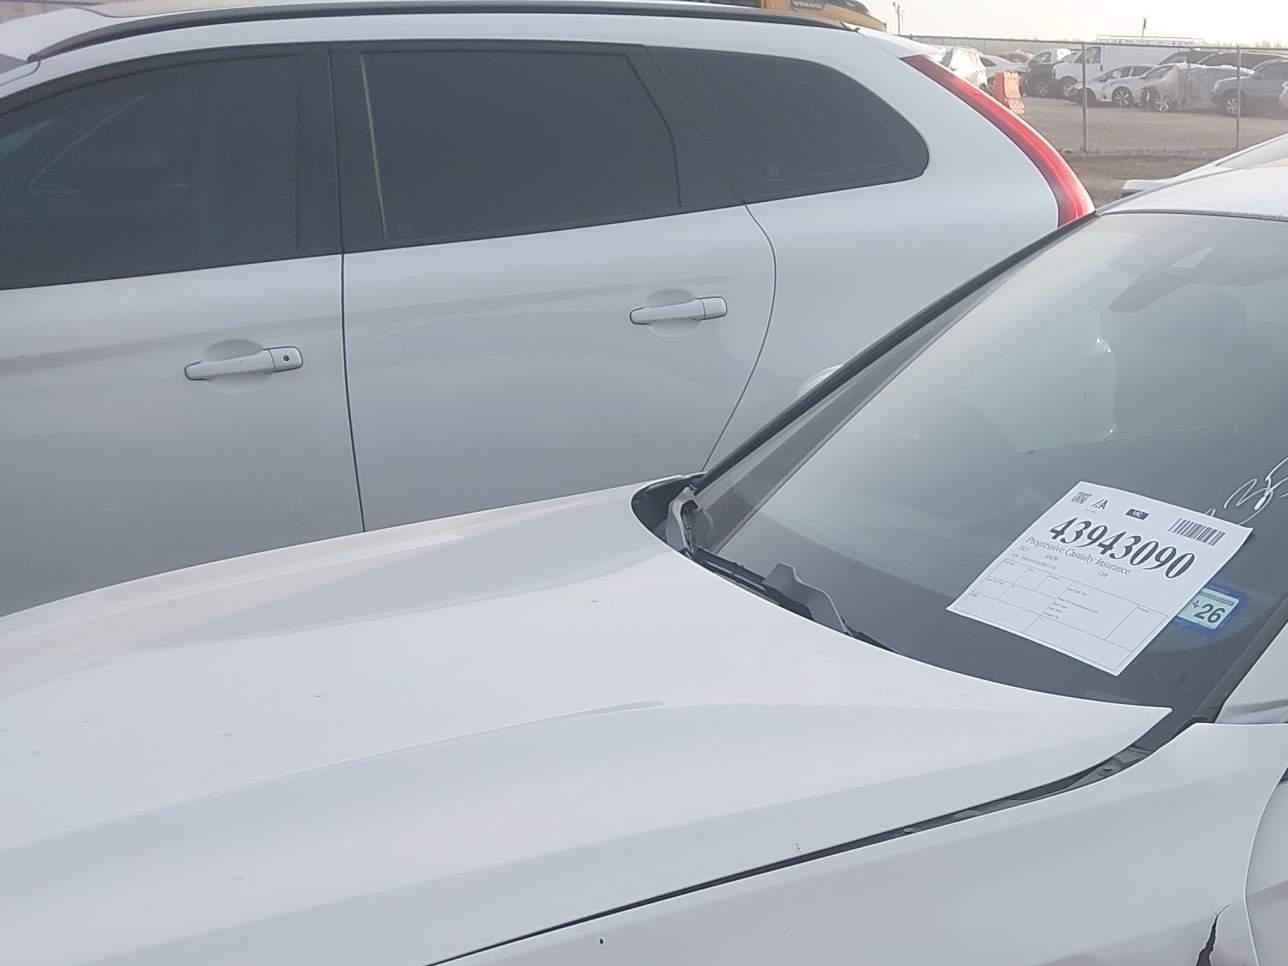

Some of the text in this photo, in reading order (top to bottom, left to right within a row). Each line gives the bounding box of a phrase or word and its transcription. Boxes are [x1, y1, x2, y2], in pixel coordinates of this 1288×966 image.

[1025, 536, 1066, 554] Progressive
[1065, 547, 1097, 565] Casualty
[1095, 558, 1131, 576] Insurance
[1048, 516, 1195, 579] 43943090
[1193, 603, 1226, 624] 26
